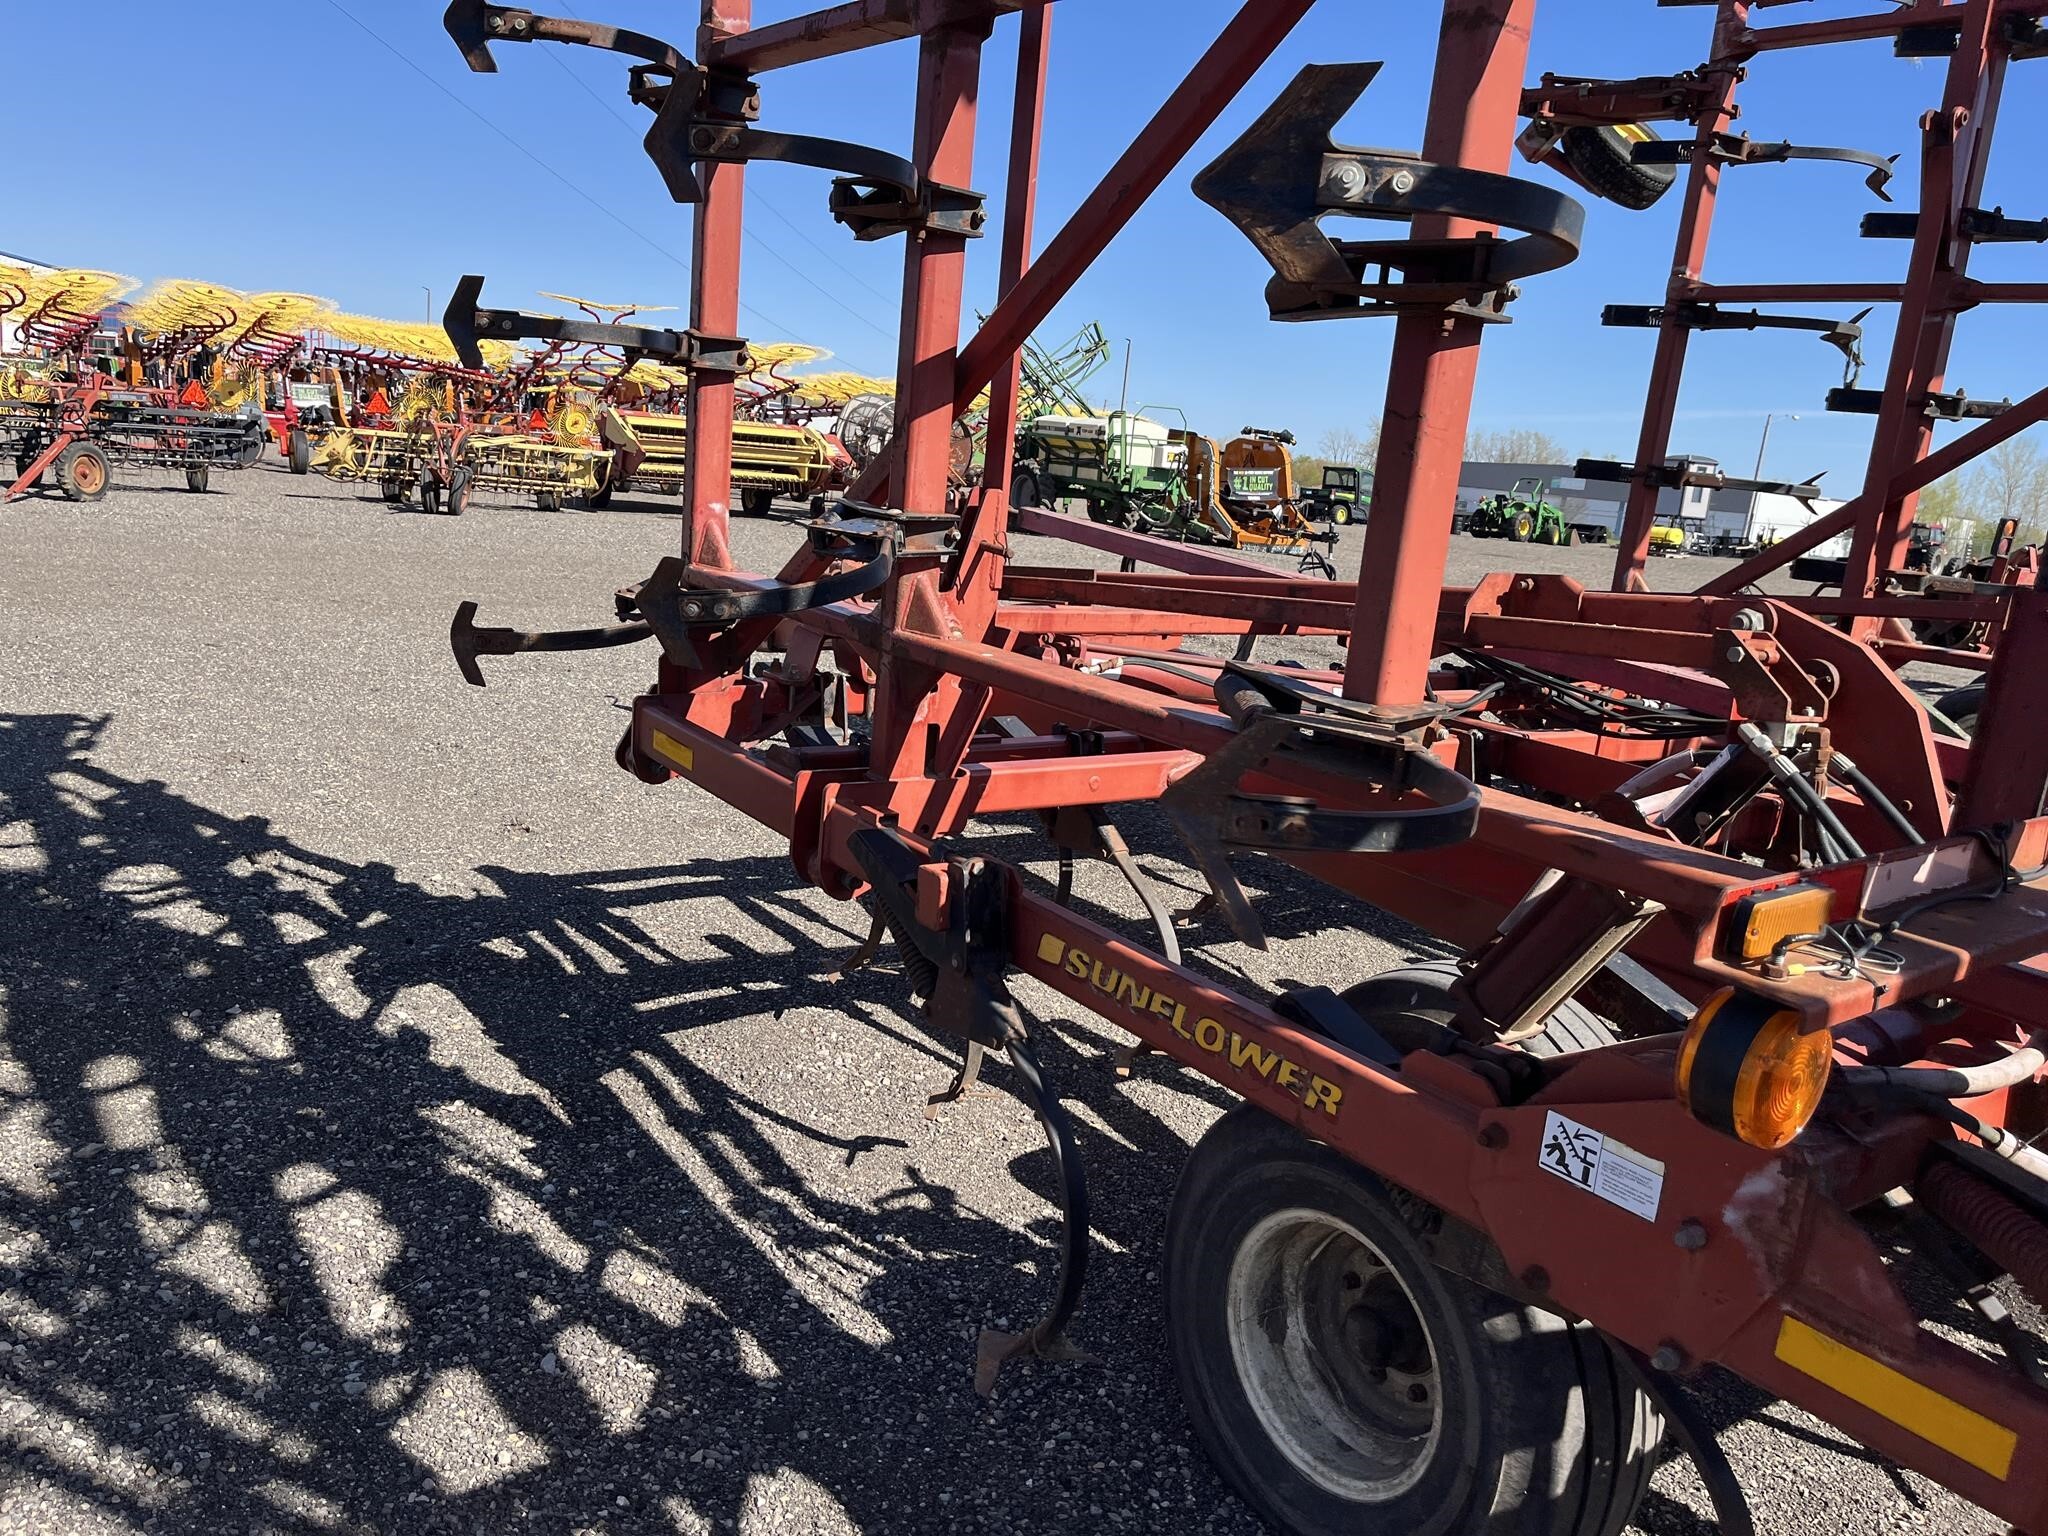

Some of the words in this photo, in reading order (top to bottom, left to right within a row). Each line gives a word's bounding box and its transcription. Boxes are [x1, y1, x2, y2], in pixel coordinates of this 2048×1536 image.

[1233, 476, 1248, 490] #1
[1249, 483, 1273, 491] QUALITY
[1065, 948, 1345, 1116] SUNFLOWER
